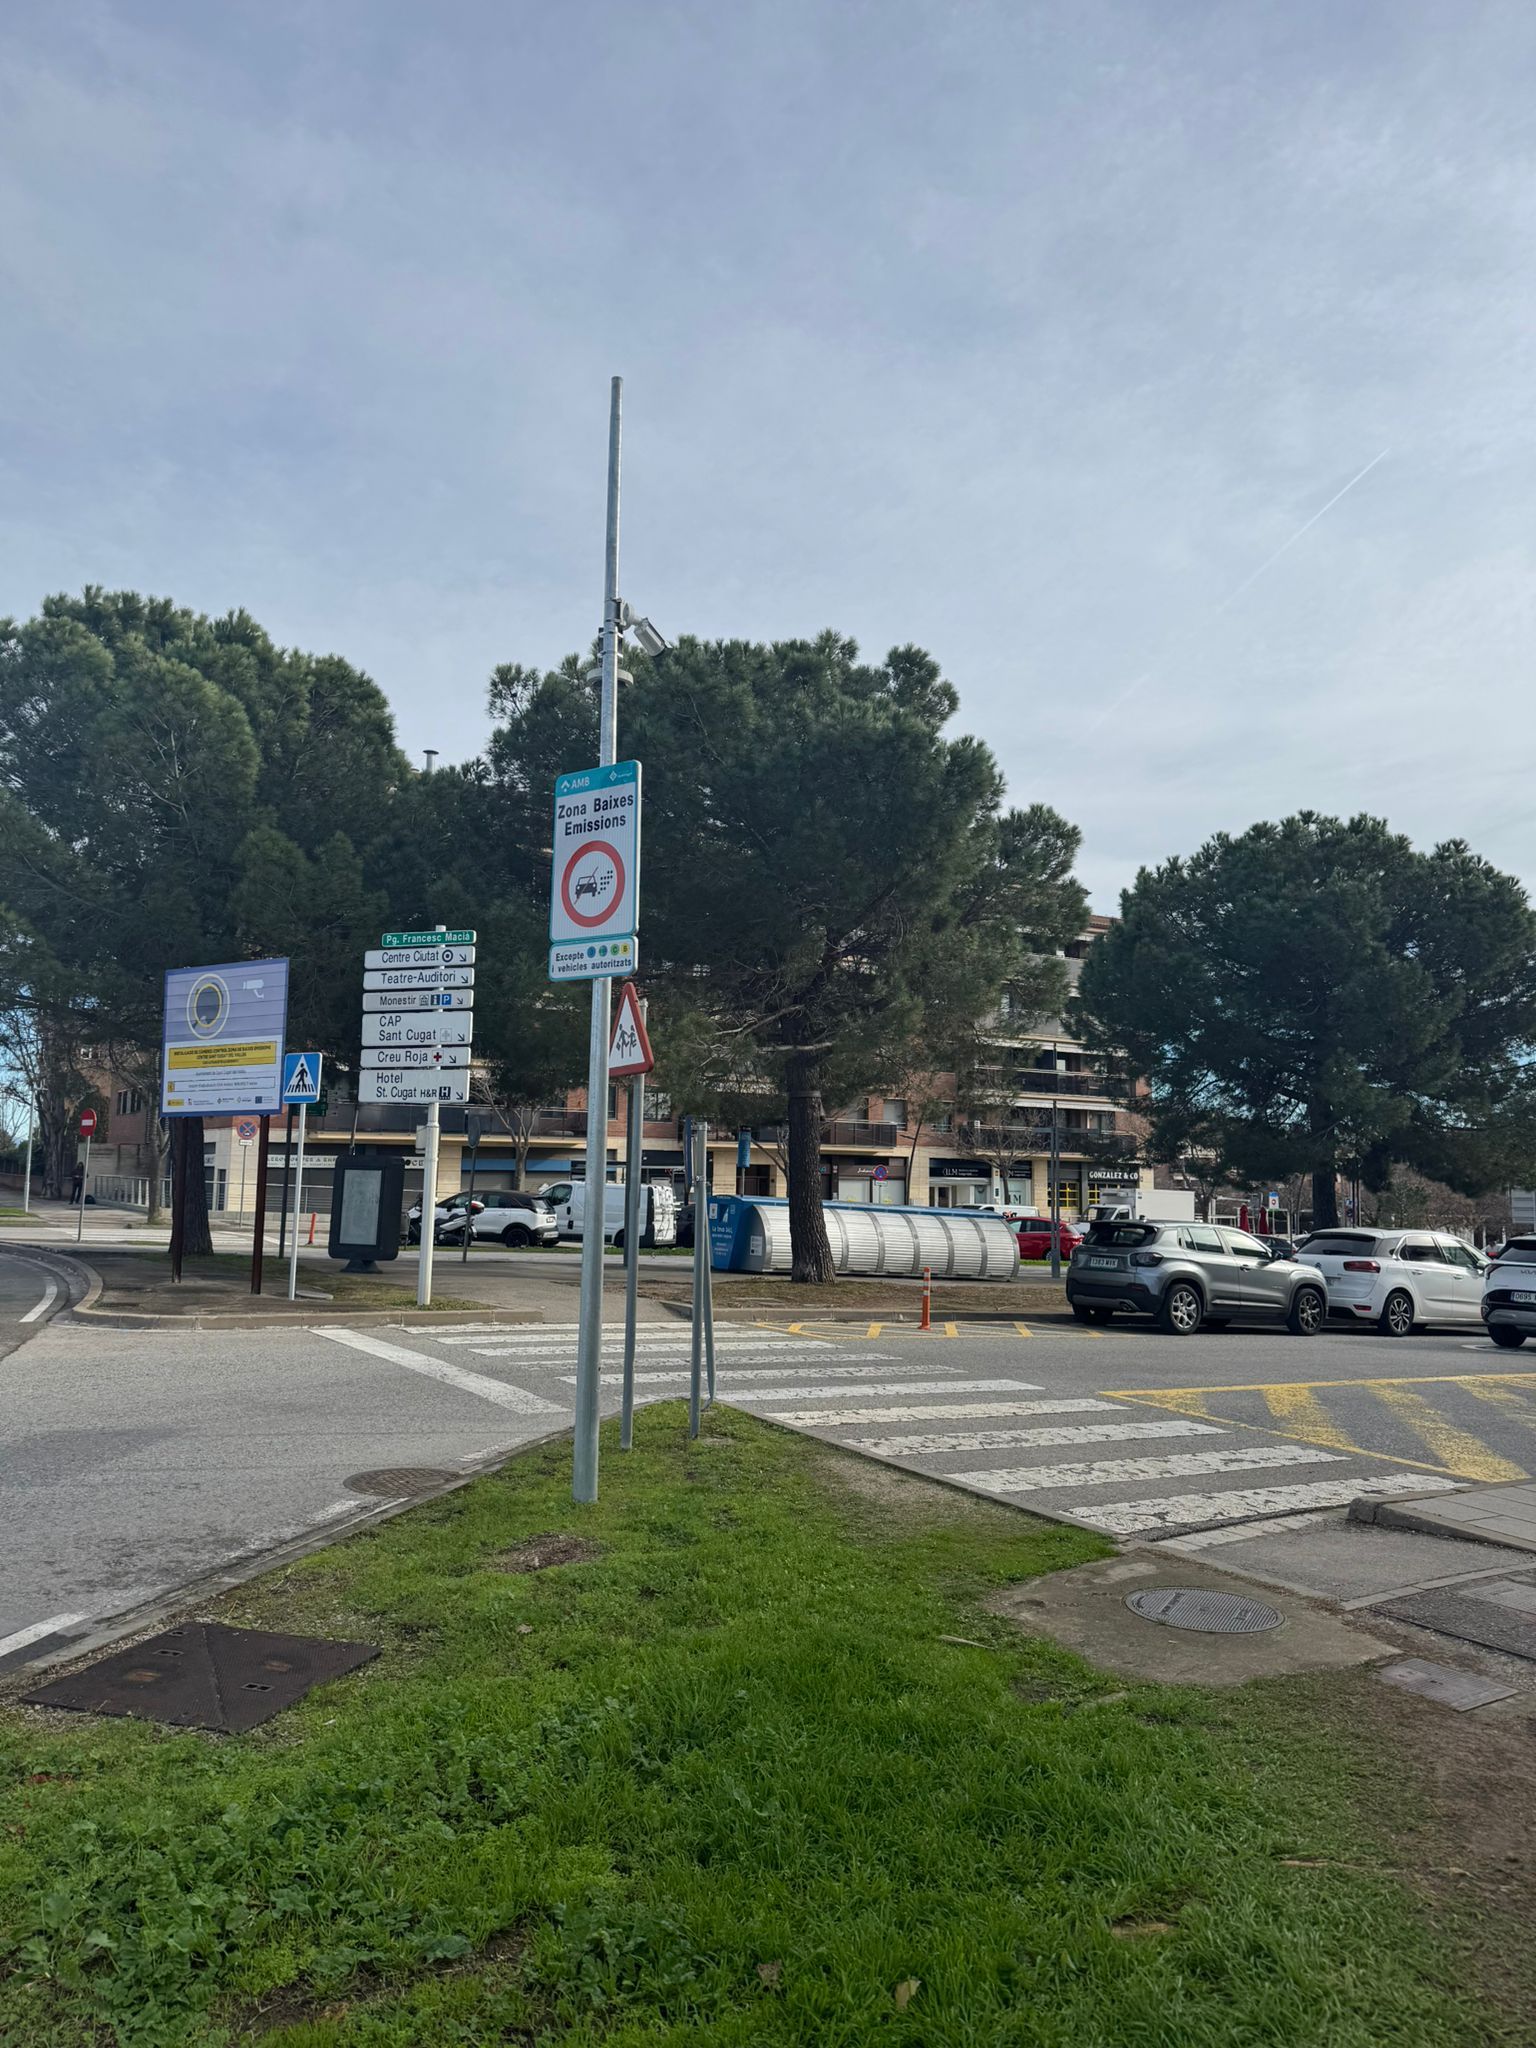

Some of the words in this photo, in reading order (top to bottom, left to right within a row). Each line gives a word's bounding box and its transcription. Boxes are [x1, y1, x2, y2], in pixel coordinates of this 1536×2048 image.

[571, 776, 590, 789] AMB
[558, 803, 587, 820] Zona
[594, 794, 634, 813] Baixes
[565, 814, 626, 836] Emissions
[386, 935, 400, 946] Pg.
[402, 934, 442, 943] Francesc
[445, 932, 470, 942] Macià
[381, 951, 411, 963] Centre
[413, 950, 439, 962] Ciutat
[555, 952, 585, 962] Excepte
[557, 962, 588, 973] vehicles
[591, 958, 632, 970] autoritzats
[381, 970, 456, 984] Teatre-Auditori
[379, 996, 417, 1006] Monestir
[379, 1015, 402, 1027] CAP
[378, 1029, 402, 1041] Sant
[406, 1028, 437, 1043] Cugat
[377, 1051, 401, 1063] Creu
[405, 1050, 428, 1064] Roja
[376, 1072, 403, 1084] Hotel
[376, 1086, 388, 1098] St.
[390, 1086, 417, 1101] Cugat
[420, 1089, 437, 1098] H&R
[1089, 1171, 1122, 1179] GONZALEZ
[1129, 1172, 1139, 1180] CO
